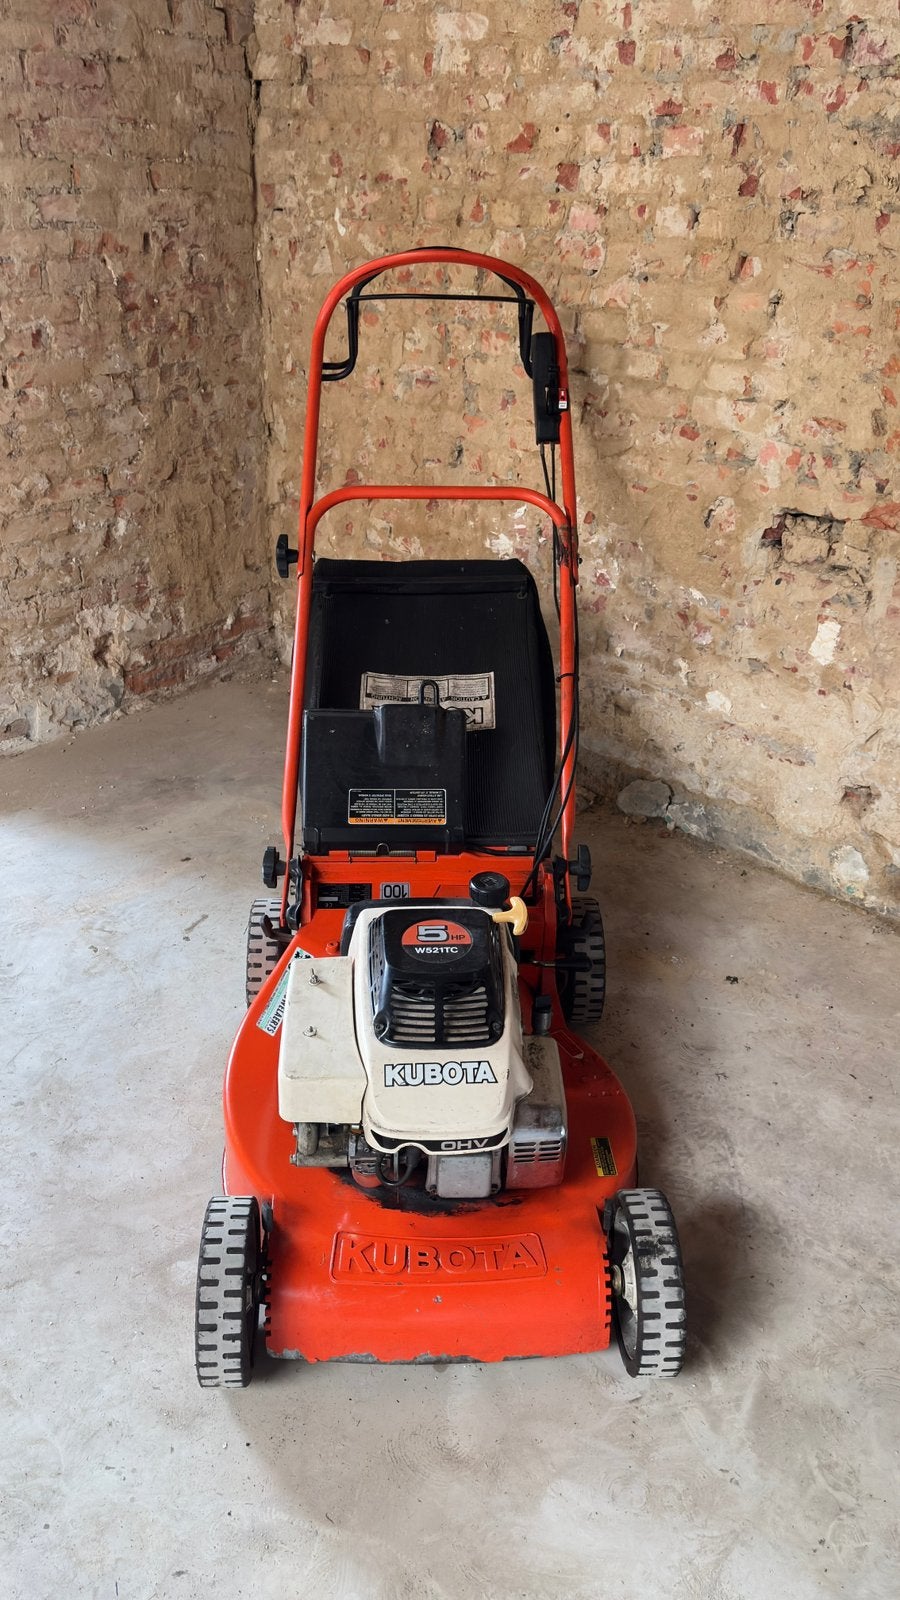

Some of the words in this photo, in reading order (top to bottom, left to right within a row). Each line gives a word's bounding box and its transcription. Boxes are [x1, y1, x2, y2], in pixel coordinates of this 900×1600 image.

[383, 885, 408, 898] 100
[416, 925, 450, 943] 5
[414, 946, 459, 954] W521TC
[384, 1060, 498, 1087] KUBOTA
[440, 1138, 489, 1151] OHV
[340, 1239, 540, 1274] KUBOTA
